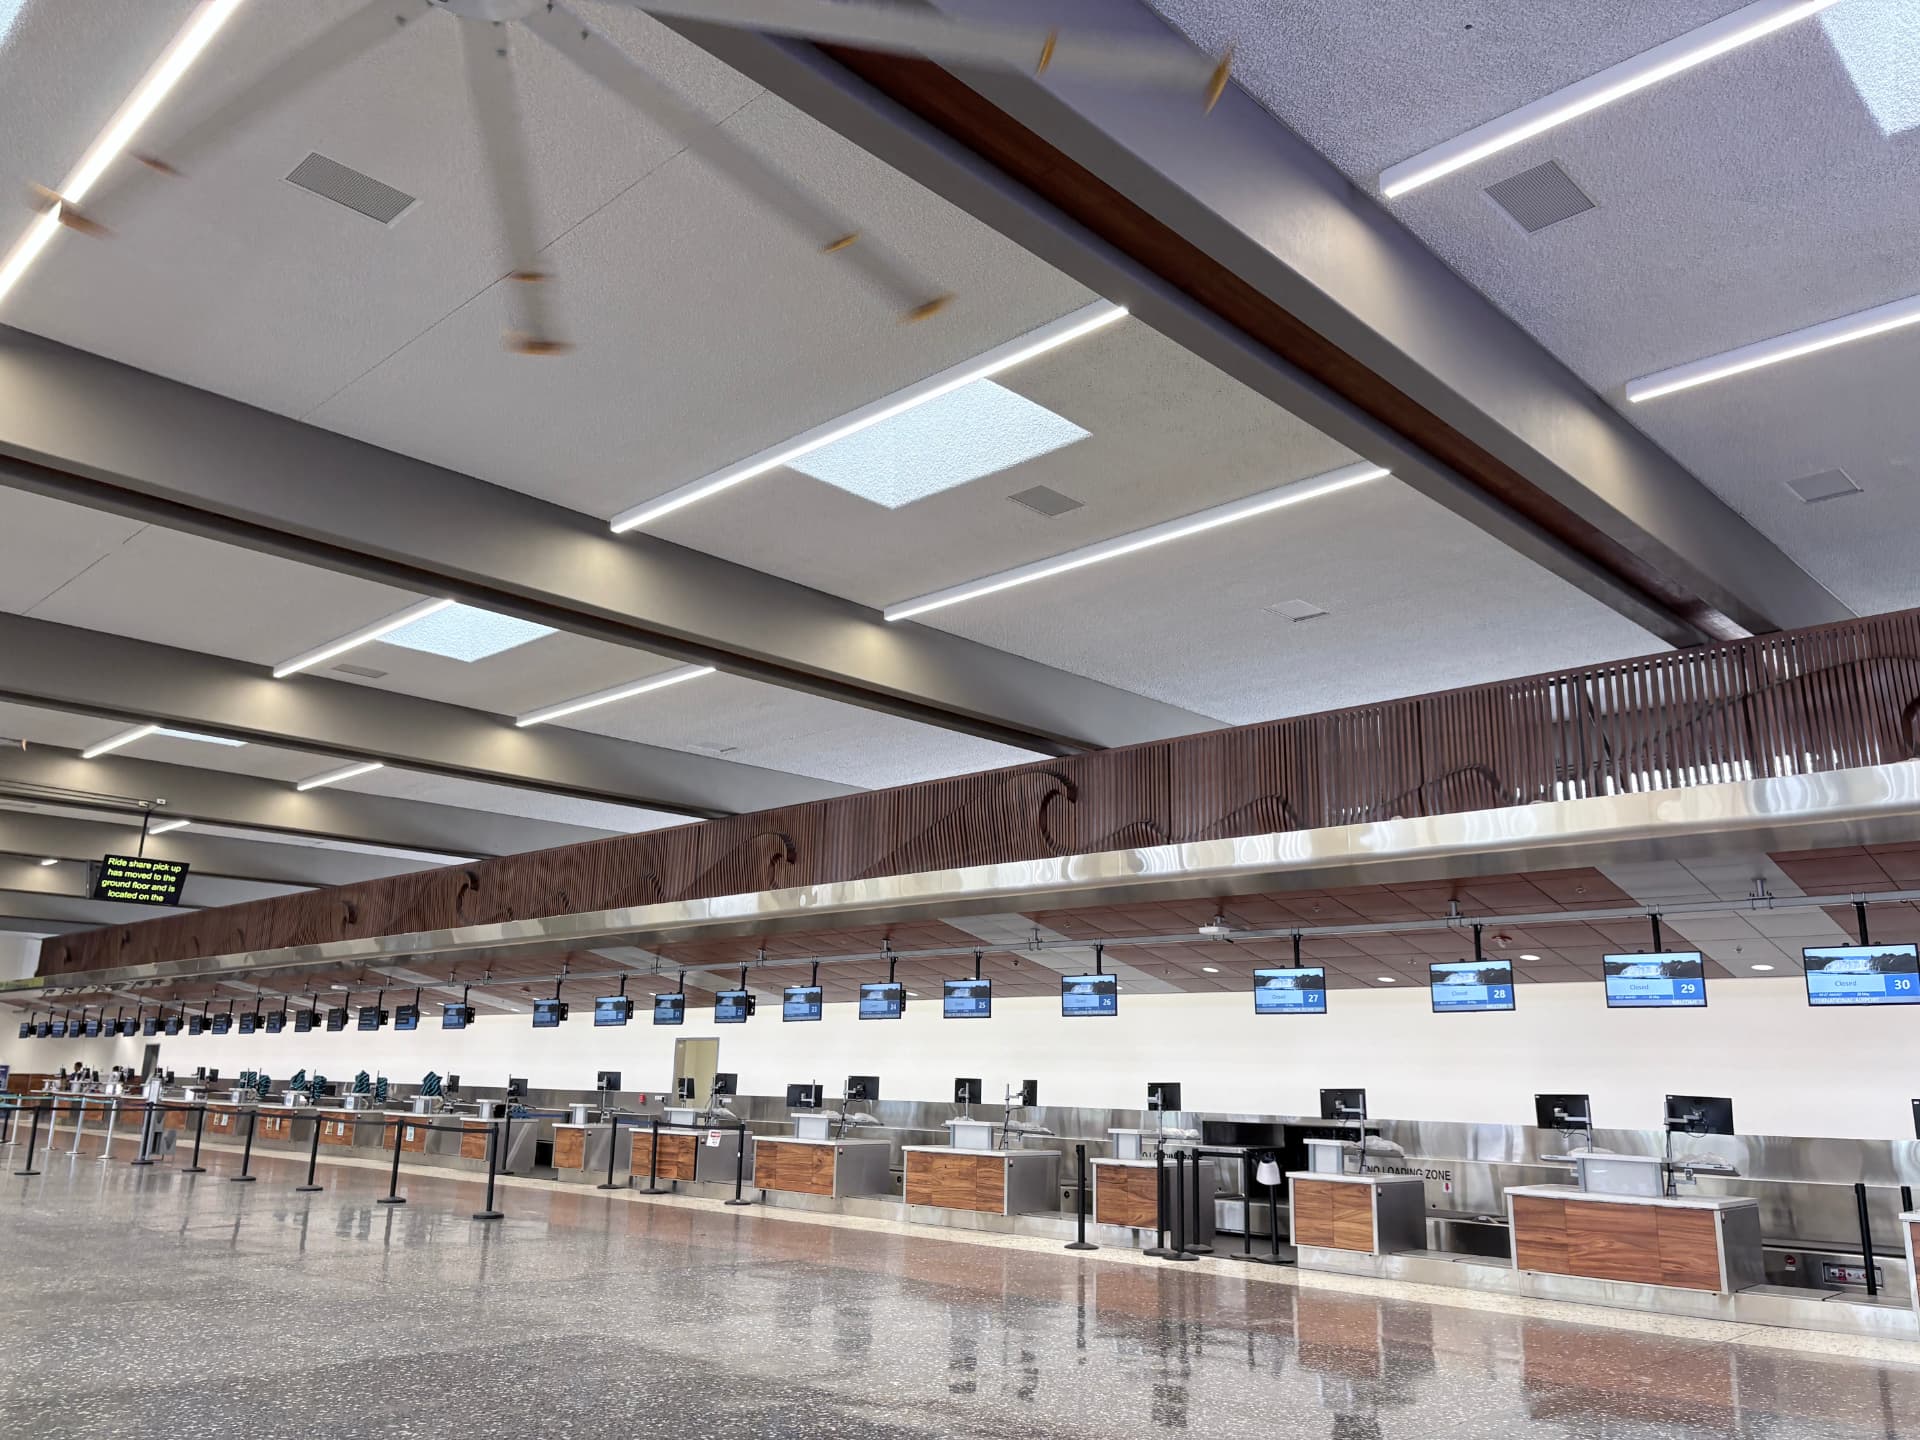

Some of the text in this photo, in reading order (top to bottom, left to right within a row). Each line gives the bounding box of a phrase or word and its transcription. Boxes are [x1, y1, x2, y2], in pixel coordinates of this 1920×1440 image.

[108, 857, 182, 873] Ride share pick up
[107, 868, 176, 882] has moved to the
[101, 879, 176, 893] ground floor and is
[107, 889, 164, 902] located on the
[1680, 983, 1696, 994] 29
[1834, 980, 1857, 988] Closed
[1894, 979, 1911, 990] 30
[1308, 994, 1319, 1003] 27
[1493, 989, 1507, 999] 28
[1383, 1167, 1423, 1176] LOADING
[1425, 1169, 1452, 1181] ZONE
